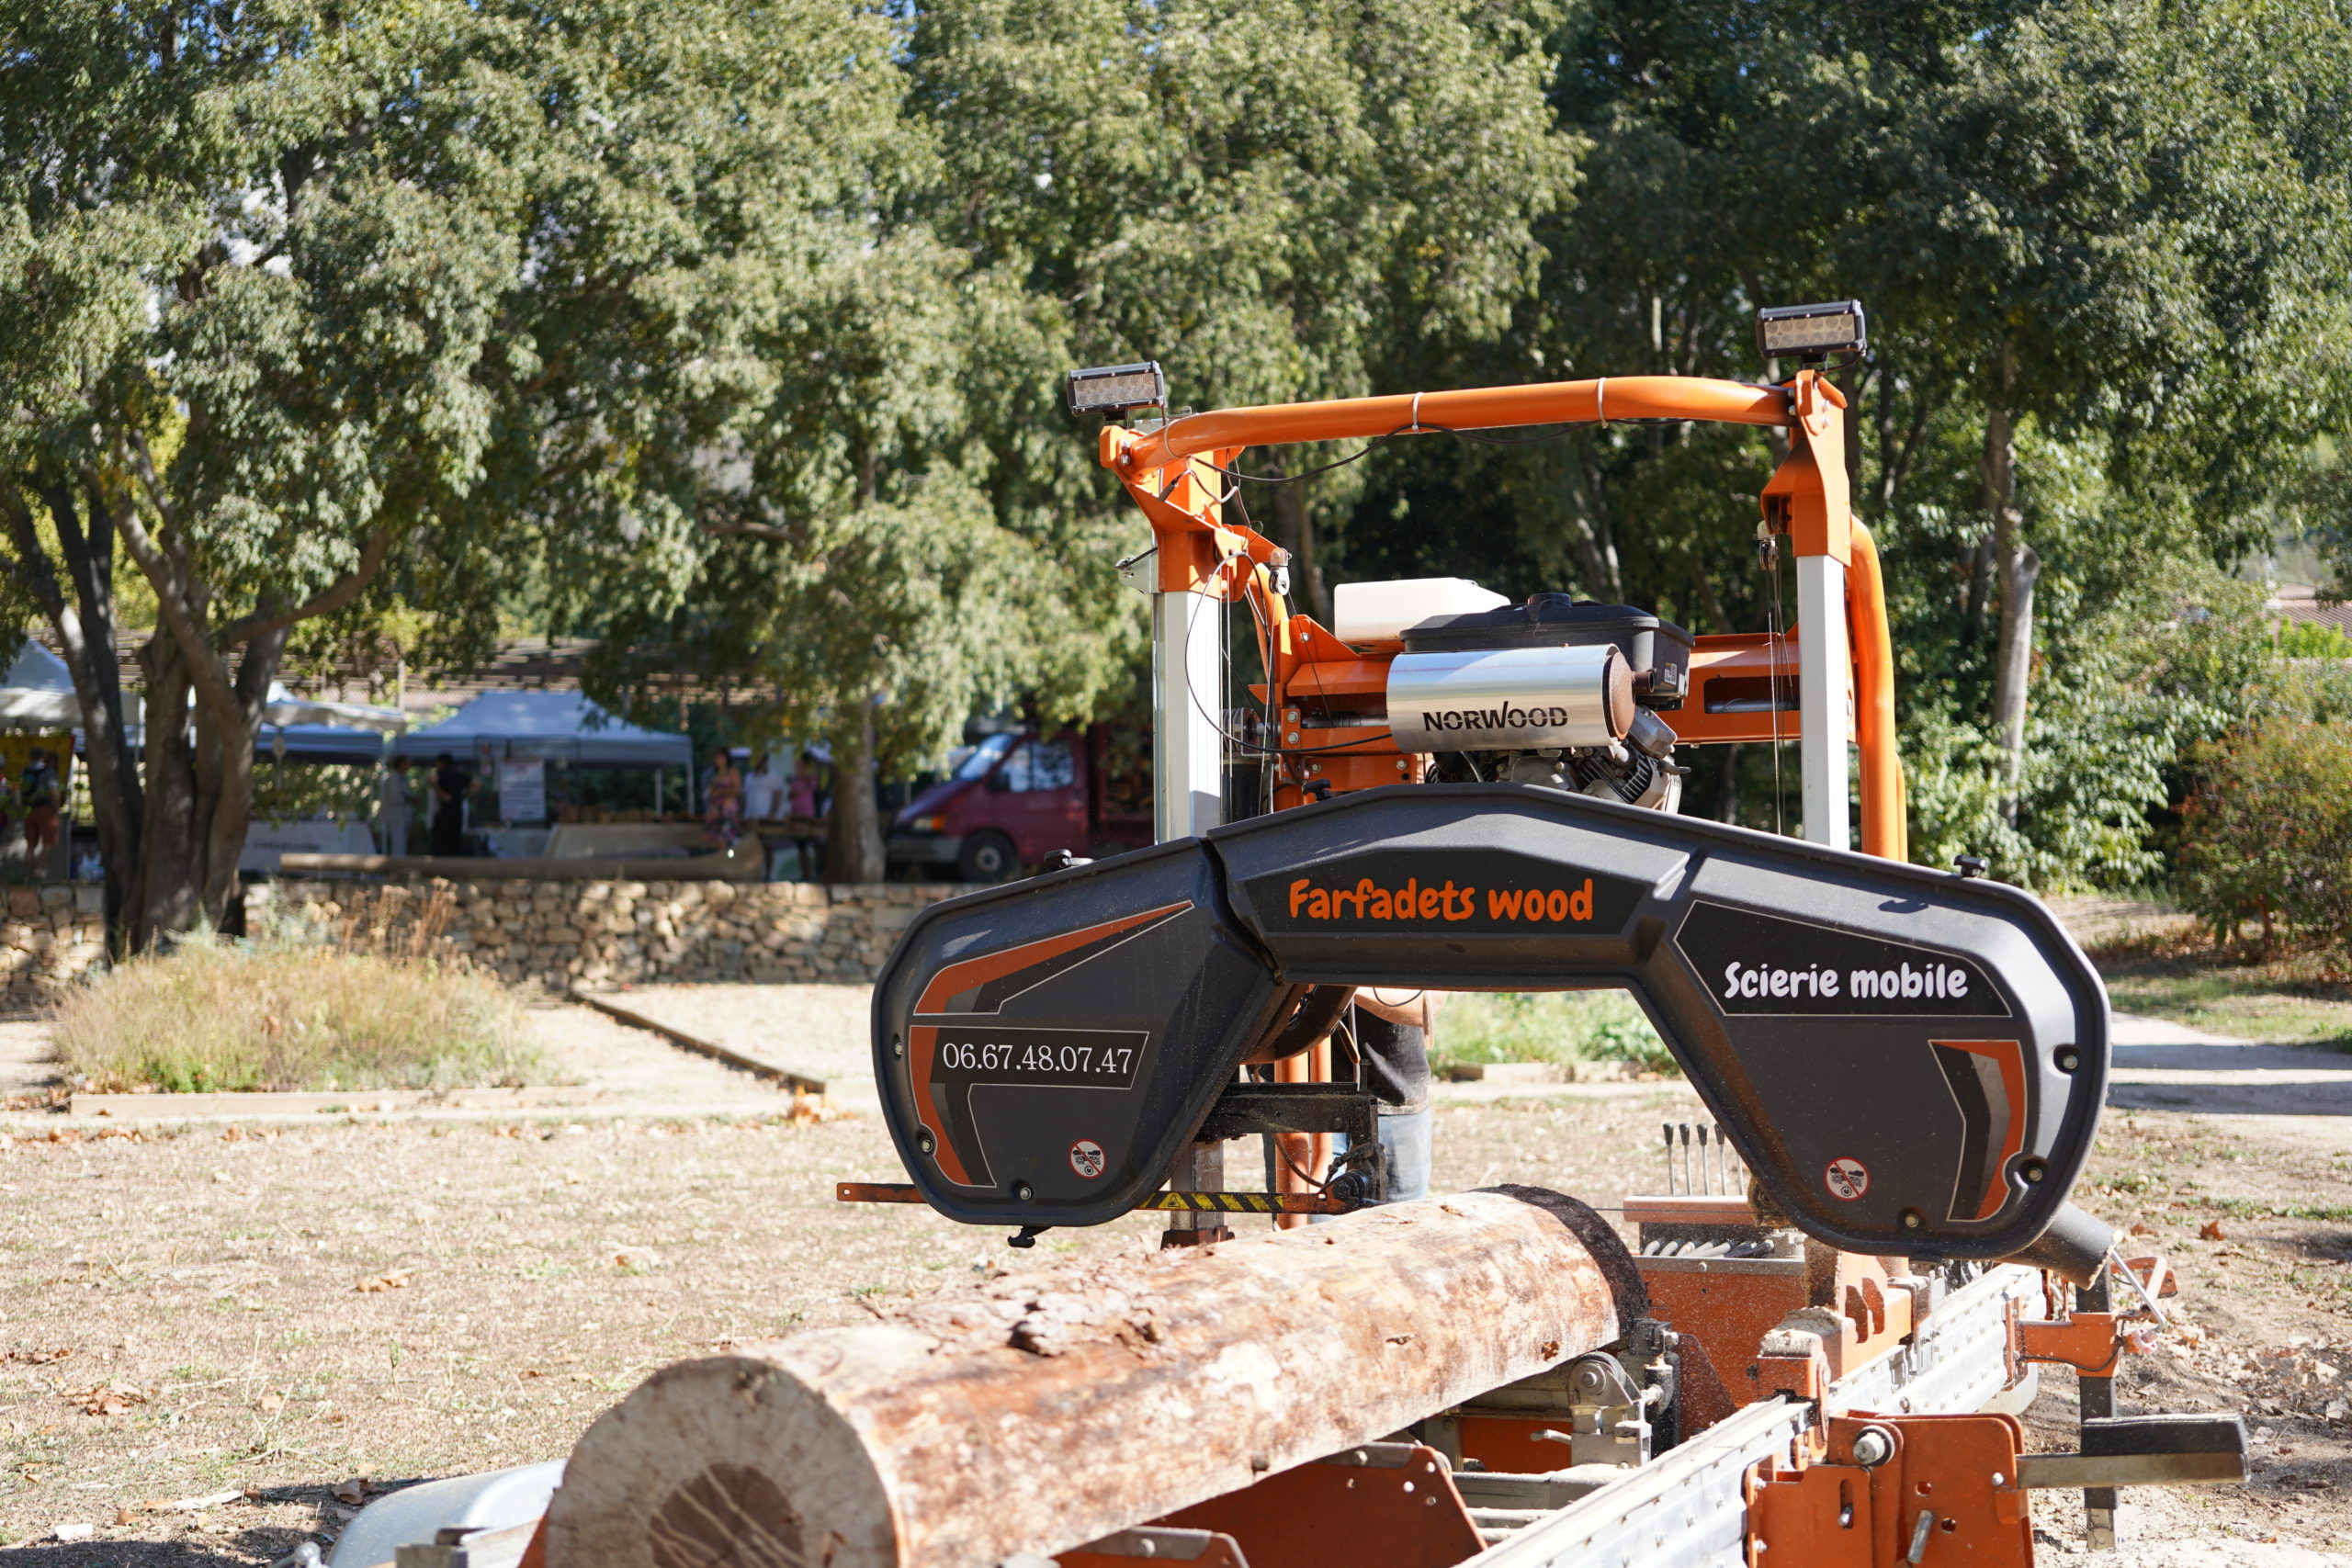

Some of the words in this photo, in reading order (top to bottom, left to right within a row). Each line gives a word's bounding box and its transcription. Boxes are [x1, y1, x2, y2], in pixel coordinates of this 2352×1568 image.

[1422, 701, 1568, 732] NORWOOD
[1289, 878, 1476, 921] Farfadets
[1487, 878, 1594, 922] wood
[1724, 961, 1840, 998] Scierie
[1850, 961, 1968, 998] mobile
[943, 1042, 1133, 1074] 06.67.48.07.47
